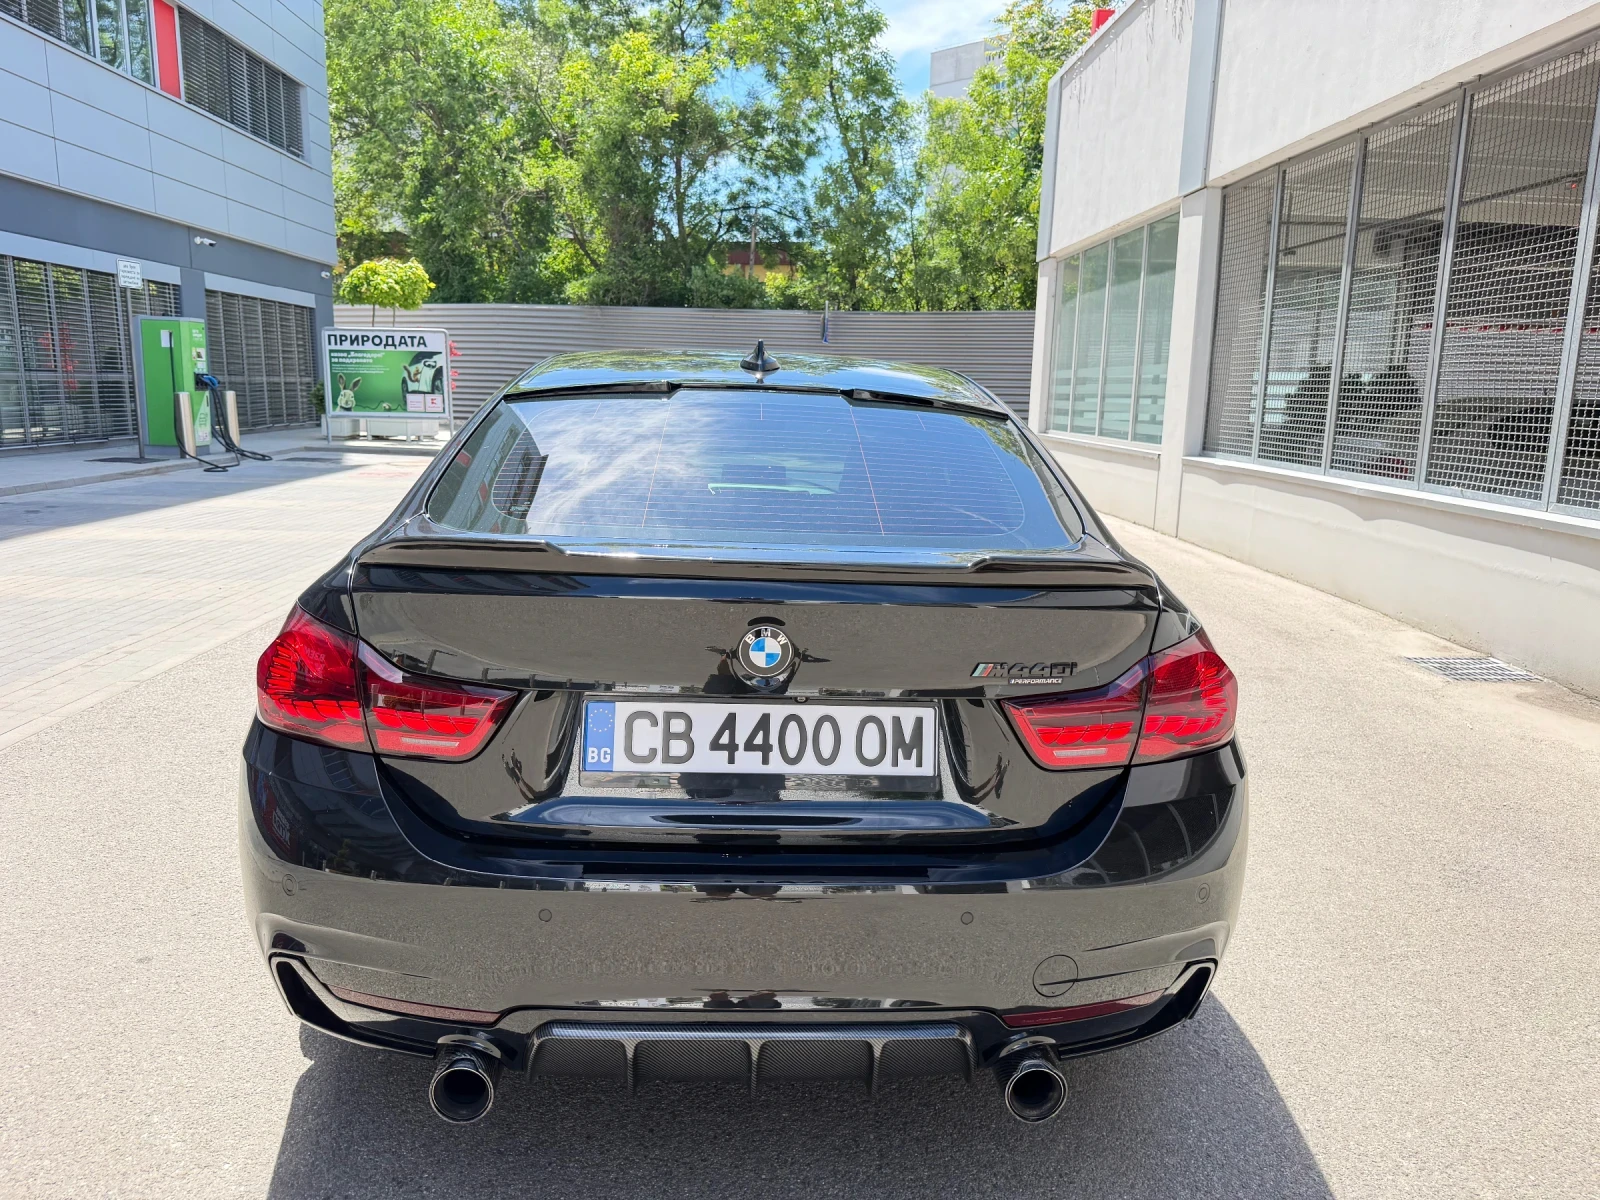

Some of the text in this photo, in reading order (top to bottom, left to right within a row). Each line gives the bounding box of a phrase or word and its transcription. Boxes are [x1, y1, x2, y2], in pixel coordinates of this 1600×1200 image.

[328, 334, 427, 349] ПРИРОДАТА
[744, 628, 787, 645] BMW
[709, 712, 841, 766] 4400
[587, 747, 611, 764] BG
